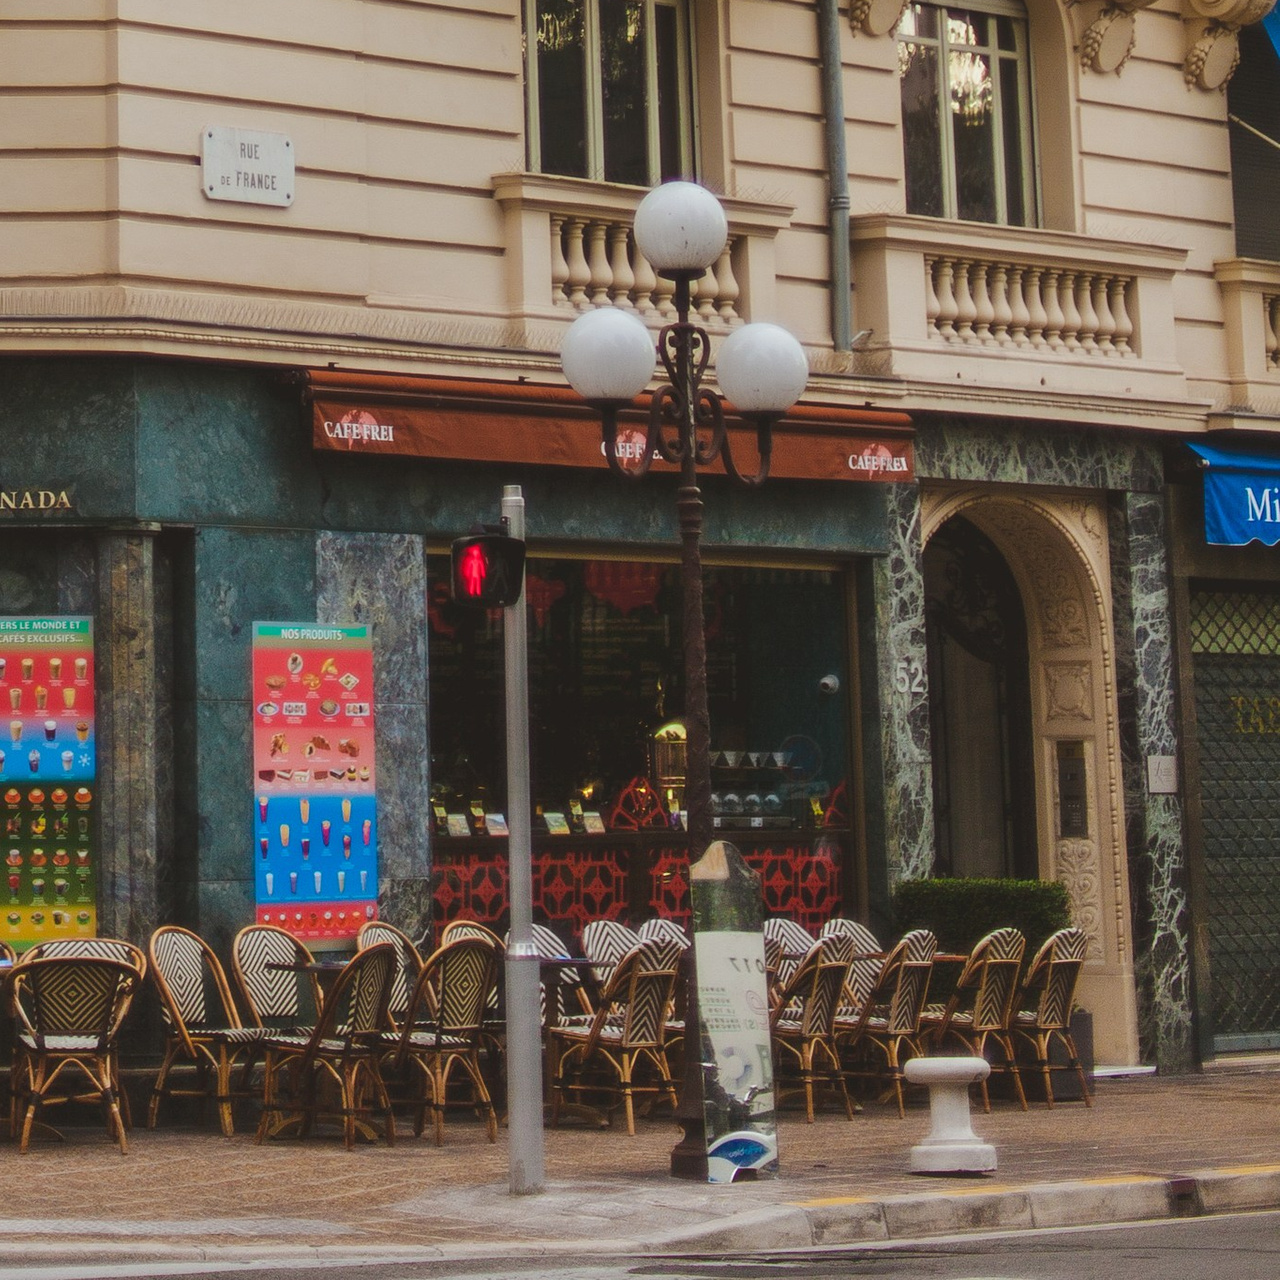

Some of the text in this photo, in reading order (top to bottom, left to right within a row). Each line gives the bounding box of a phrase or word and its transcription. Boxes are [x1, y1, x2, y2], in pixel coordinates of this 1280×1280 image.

[240, 142, 259, 159] RUE
[221, 171, 277, 191] DE FRANCE
[324, 421, 394, 441] CAFE FREI
[848, 455, 878, 470] CAFE
[19, 621, 30, 629] LE
[32, 621, 67, 629] MONDE
[70, 621, 80, 629] ET
[281, 628, 342, 640] NOS PRODUITS
[897, 662, 923, 692] 52
